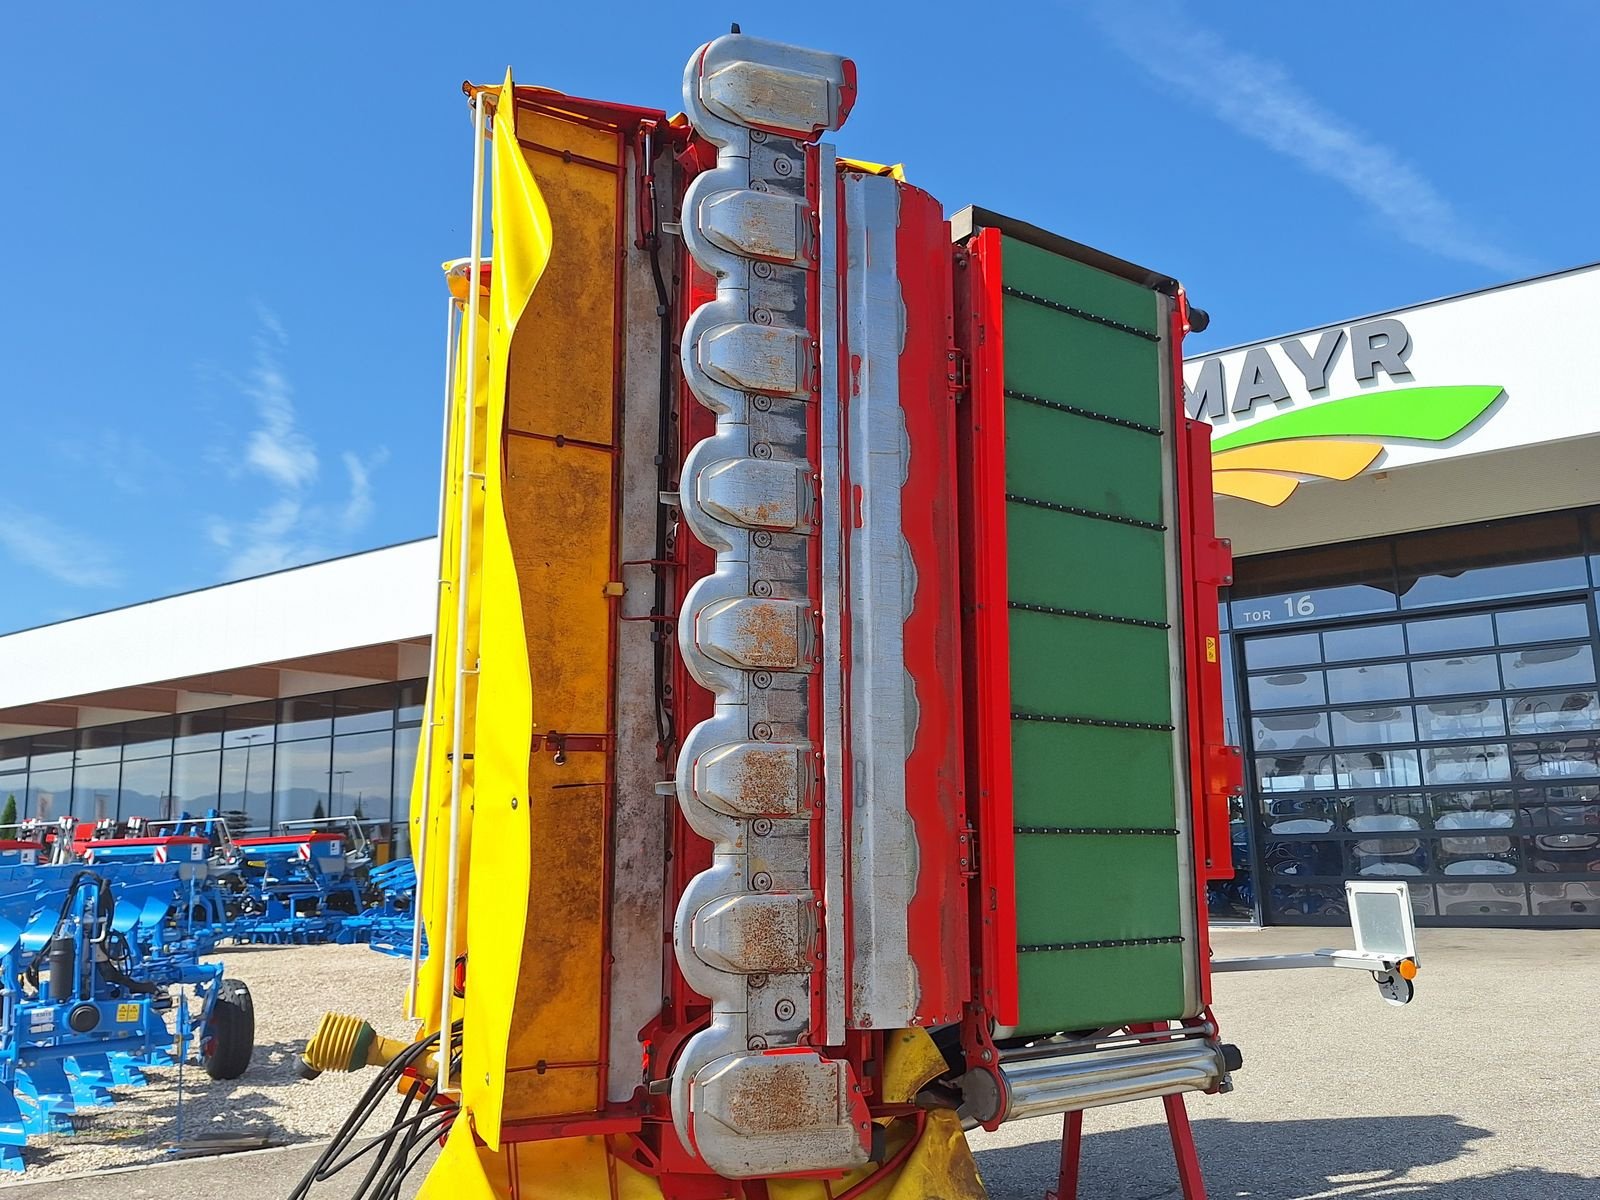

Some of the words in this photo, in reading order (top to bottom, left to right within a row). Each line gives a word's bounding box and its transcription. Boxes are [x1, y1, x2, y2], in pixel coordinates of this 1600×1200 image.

[1184, 318, 1412, 420] MAYR
[1243, 610, 1271, 622] TOR
[1284, 595, 1315, 617] 16
